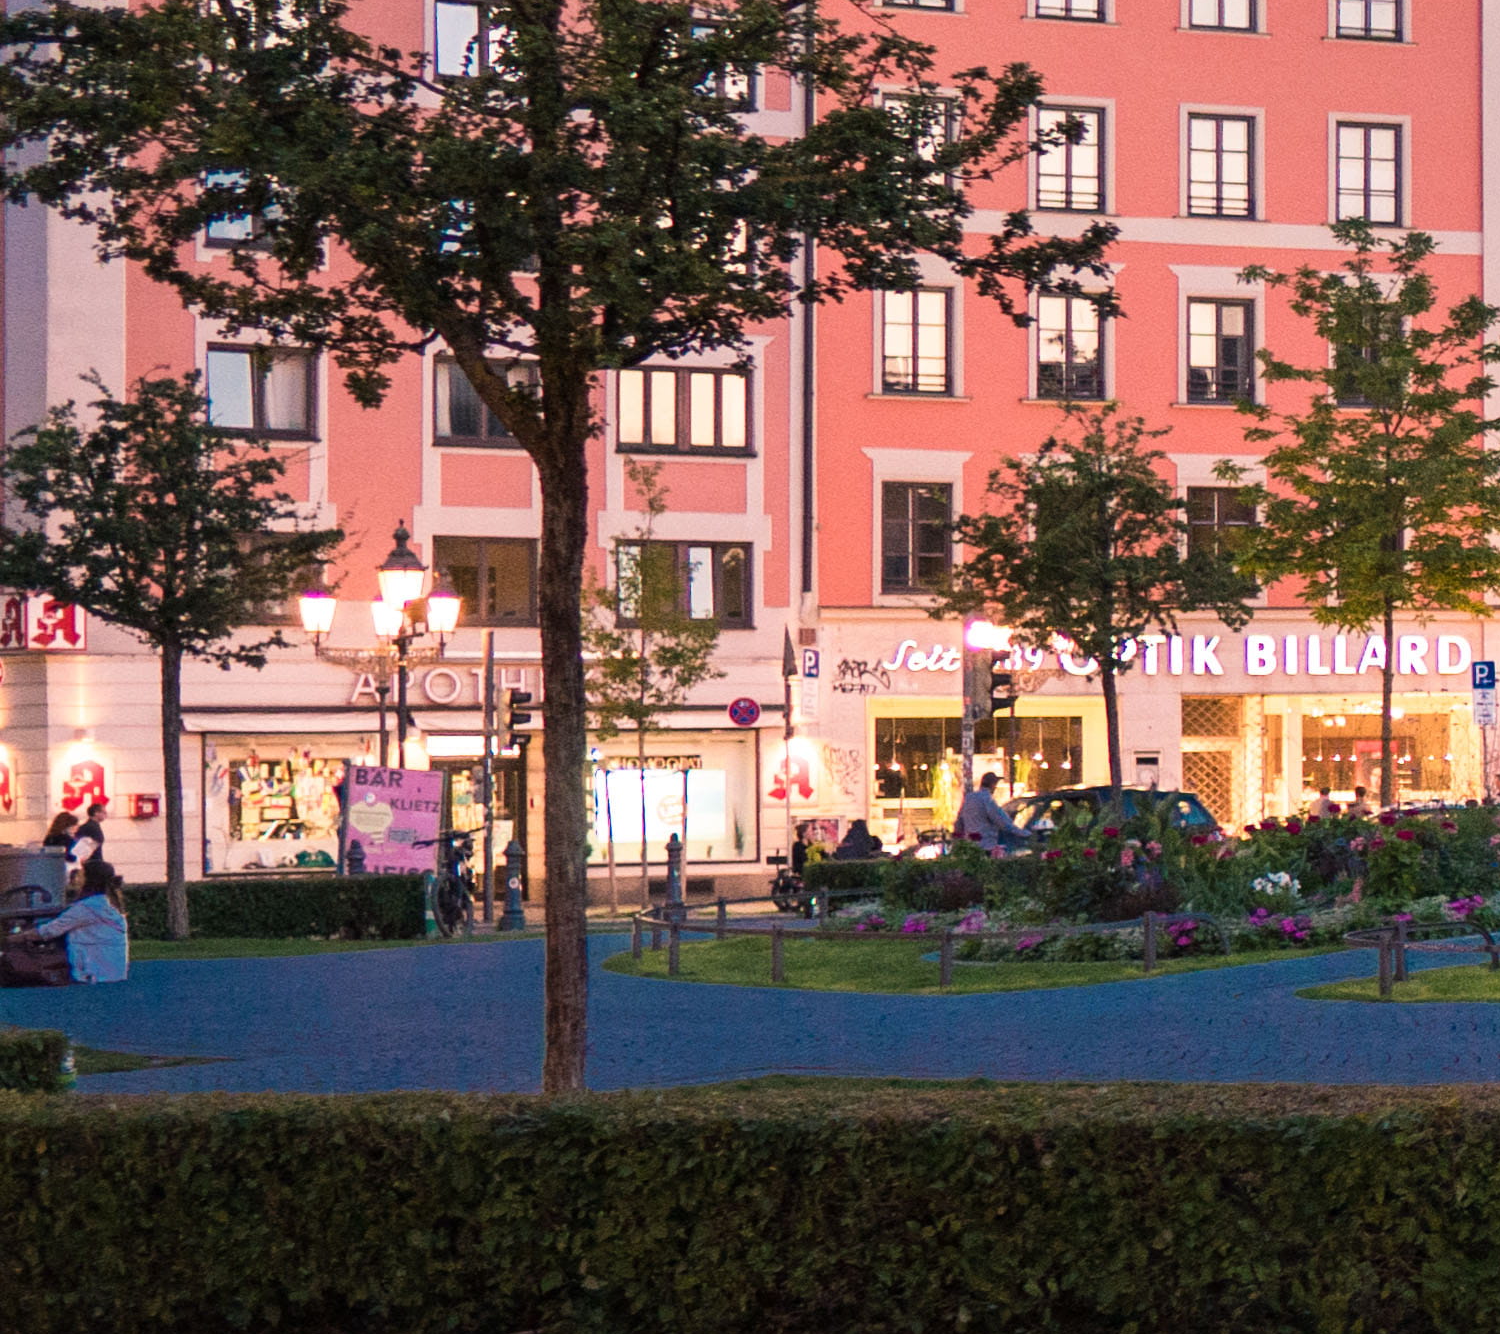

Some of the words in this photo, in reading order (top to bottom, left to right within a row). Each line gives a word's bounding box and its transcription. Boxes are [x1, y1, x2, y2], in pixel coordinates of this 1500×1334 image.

[883, 639, 960, 671] Seit
[1054, 633, 1224, 676] OPTIK
[1245, 634, 1473, 676] BILLARD
[355, 768, 404, 788] BÄR
[390, 798, 440, 813] KLIETZ
